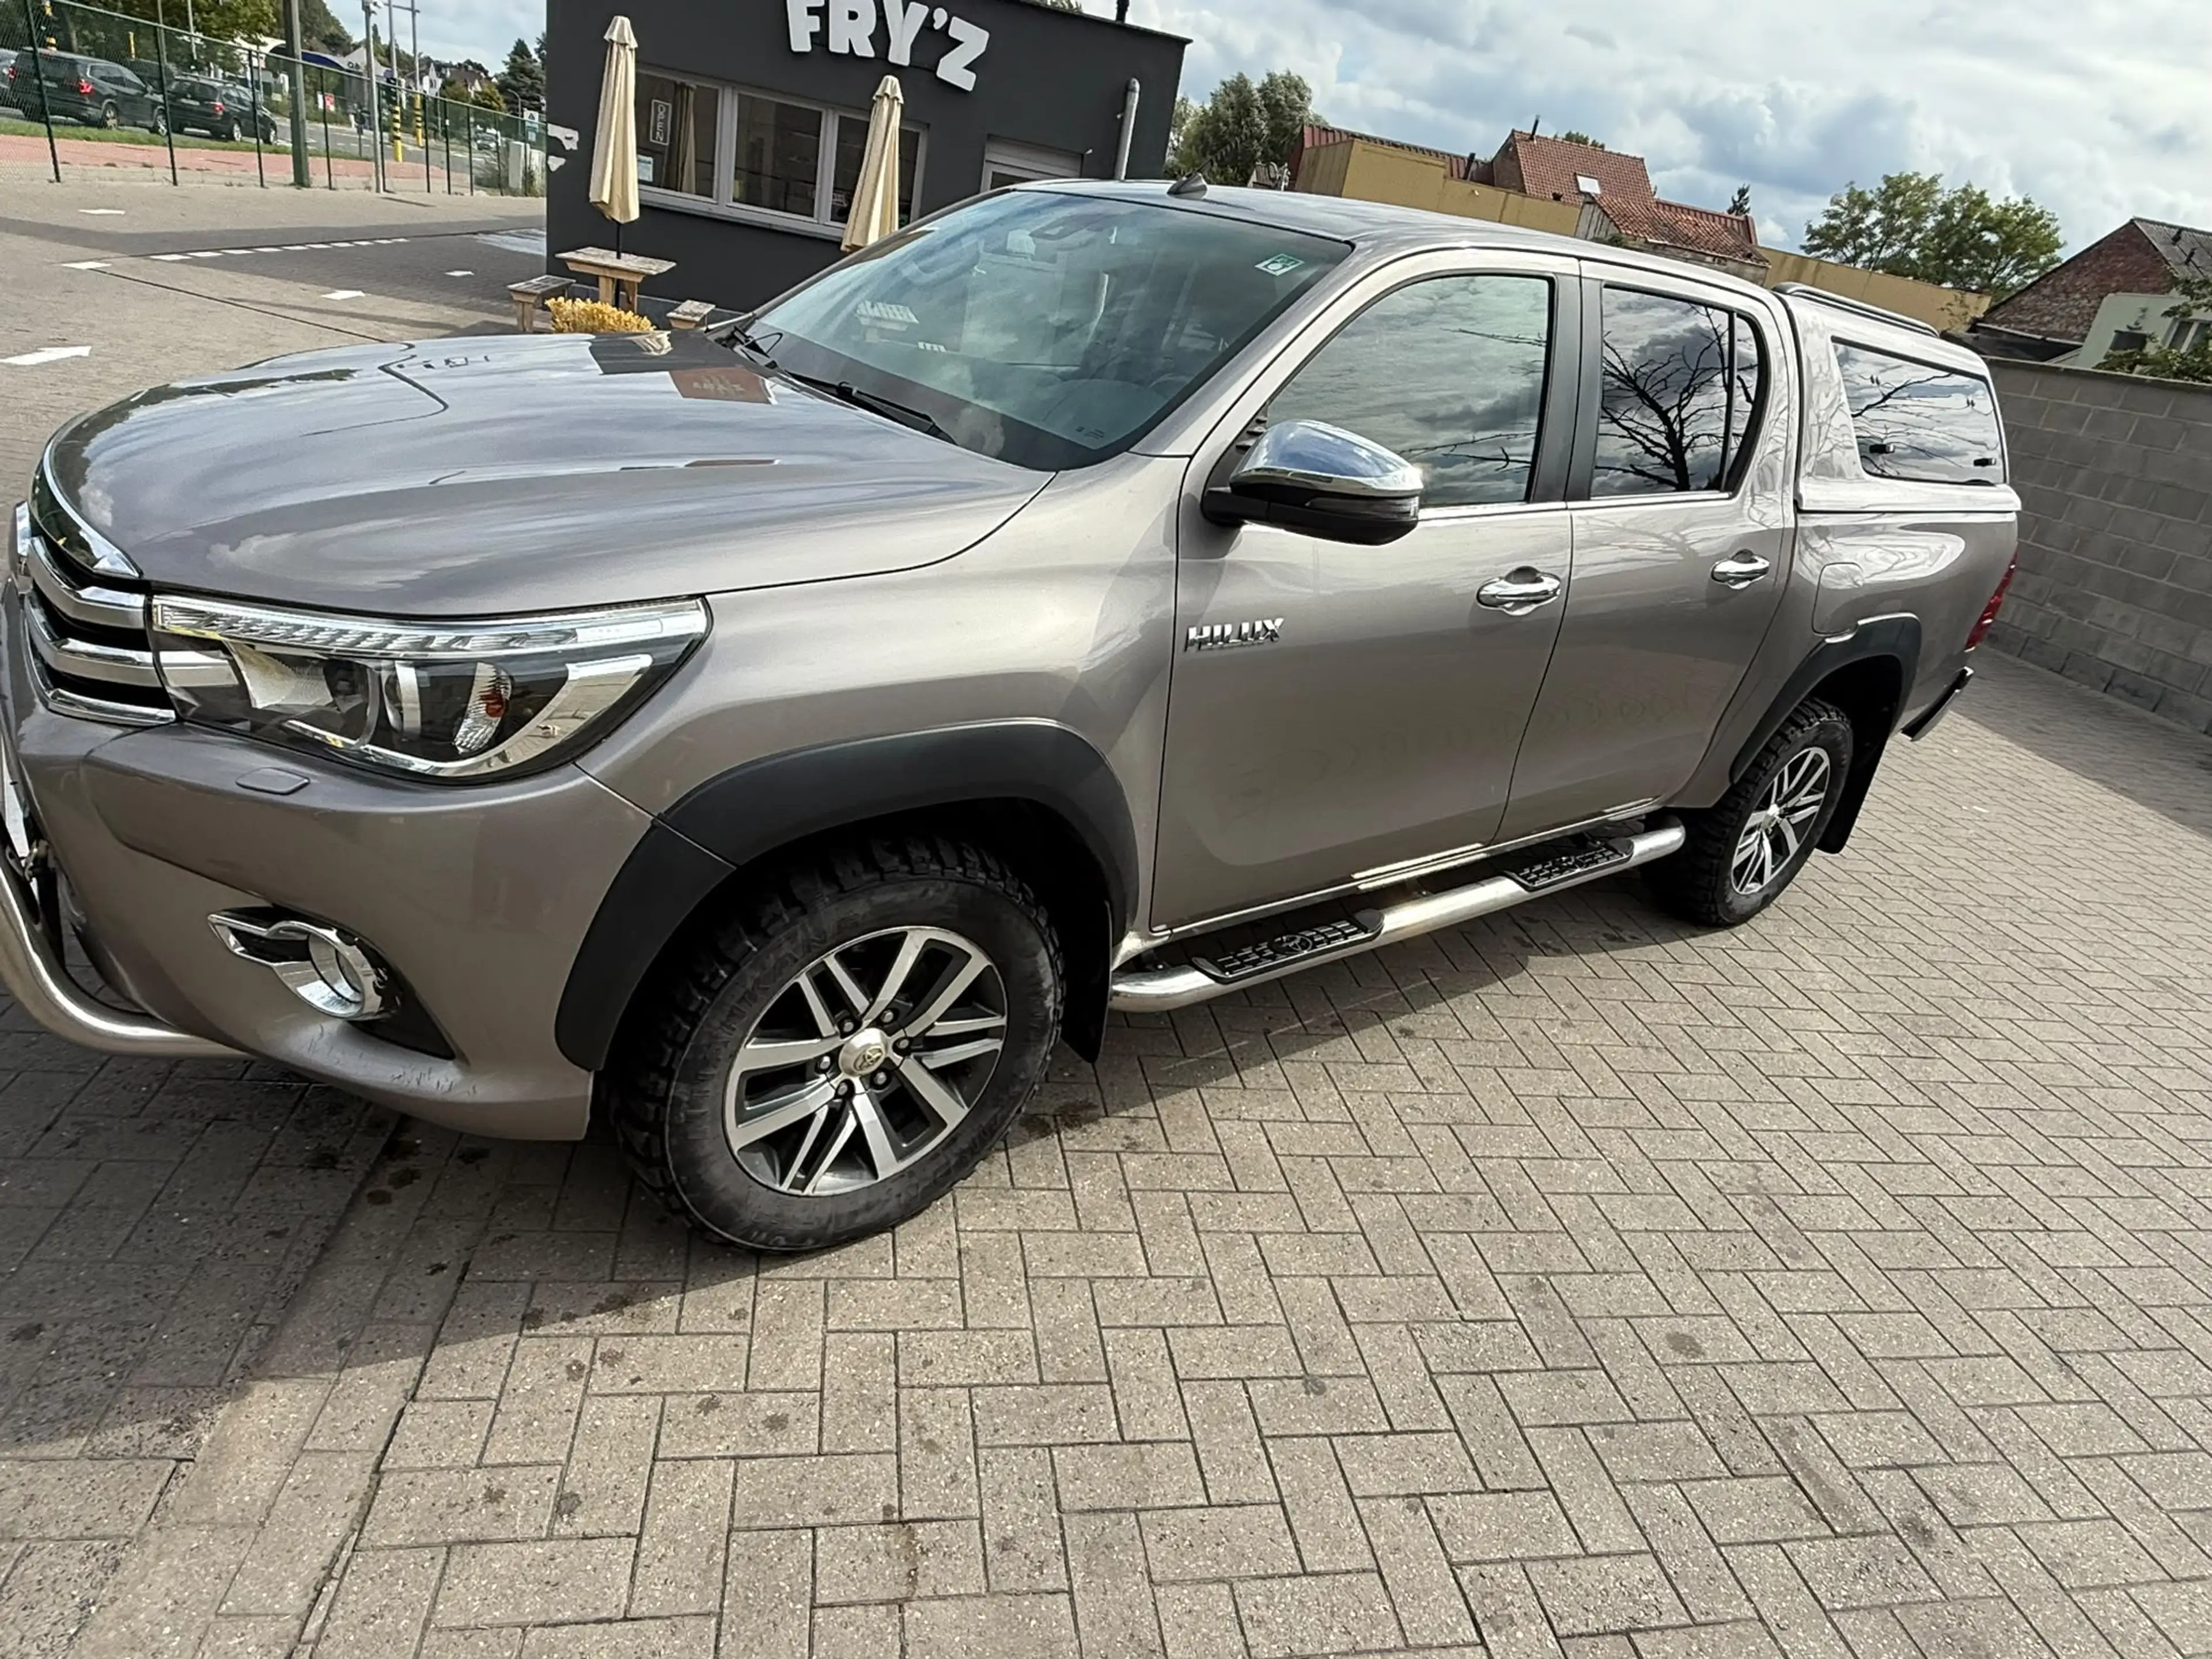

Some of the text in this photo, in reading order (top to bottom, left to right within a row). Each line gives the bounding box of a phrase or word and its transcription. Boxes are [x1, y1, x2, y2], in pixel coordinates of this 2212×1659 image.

[787, 0, 990, 92] FRY'Z
[656, 104, 666, 141] OPEN
[1185, 618, 1284, 652] HILUX
